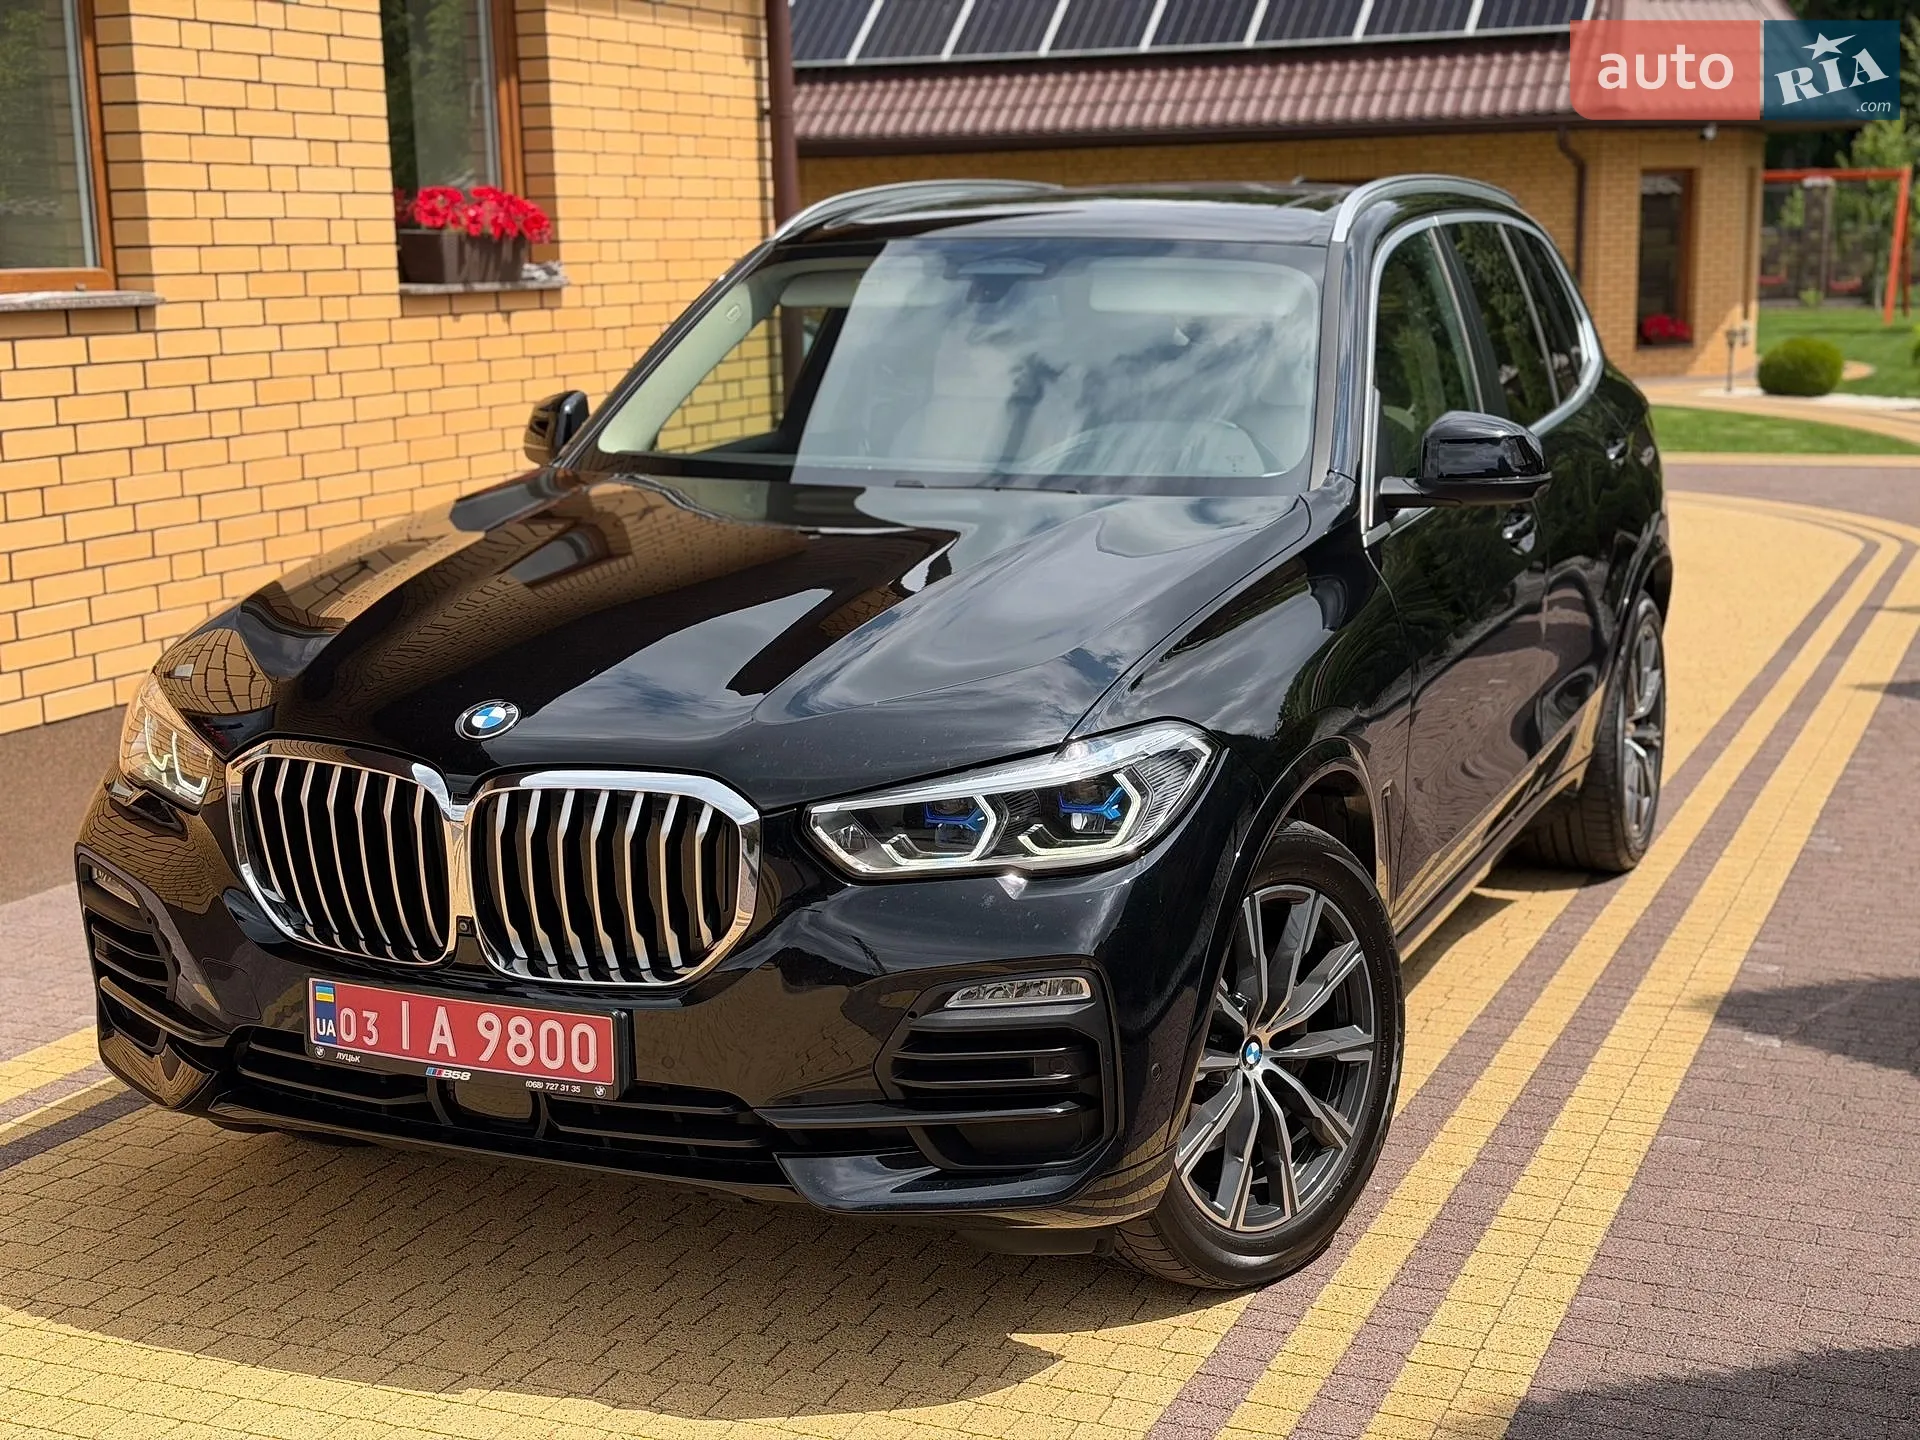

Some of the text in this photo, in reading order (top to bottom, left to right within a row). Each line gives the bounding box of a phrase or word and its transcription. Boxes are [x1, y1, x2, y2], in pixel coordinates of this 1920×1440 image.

[316, 1017, 336, 1037] UA
[339, 1007, 379, 1046] 03
[477, 1012, 598, 1073] 9800
[545, 1082, 560, 1091] 727
[560, 1084, 569, 1092] 31
[570, 1085, 581, 1093] 35
